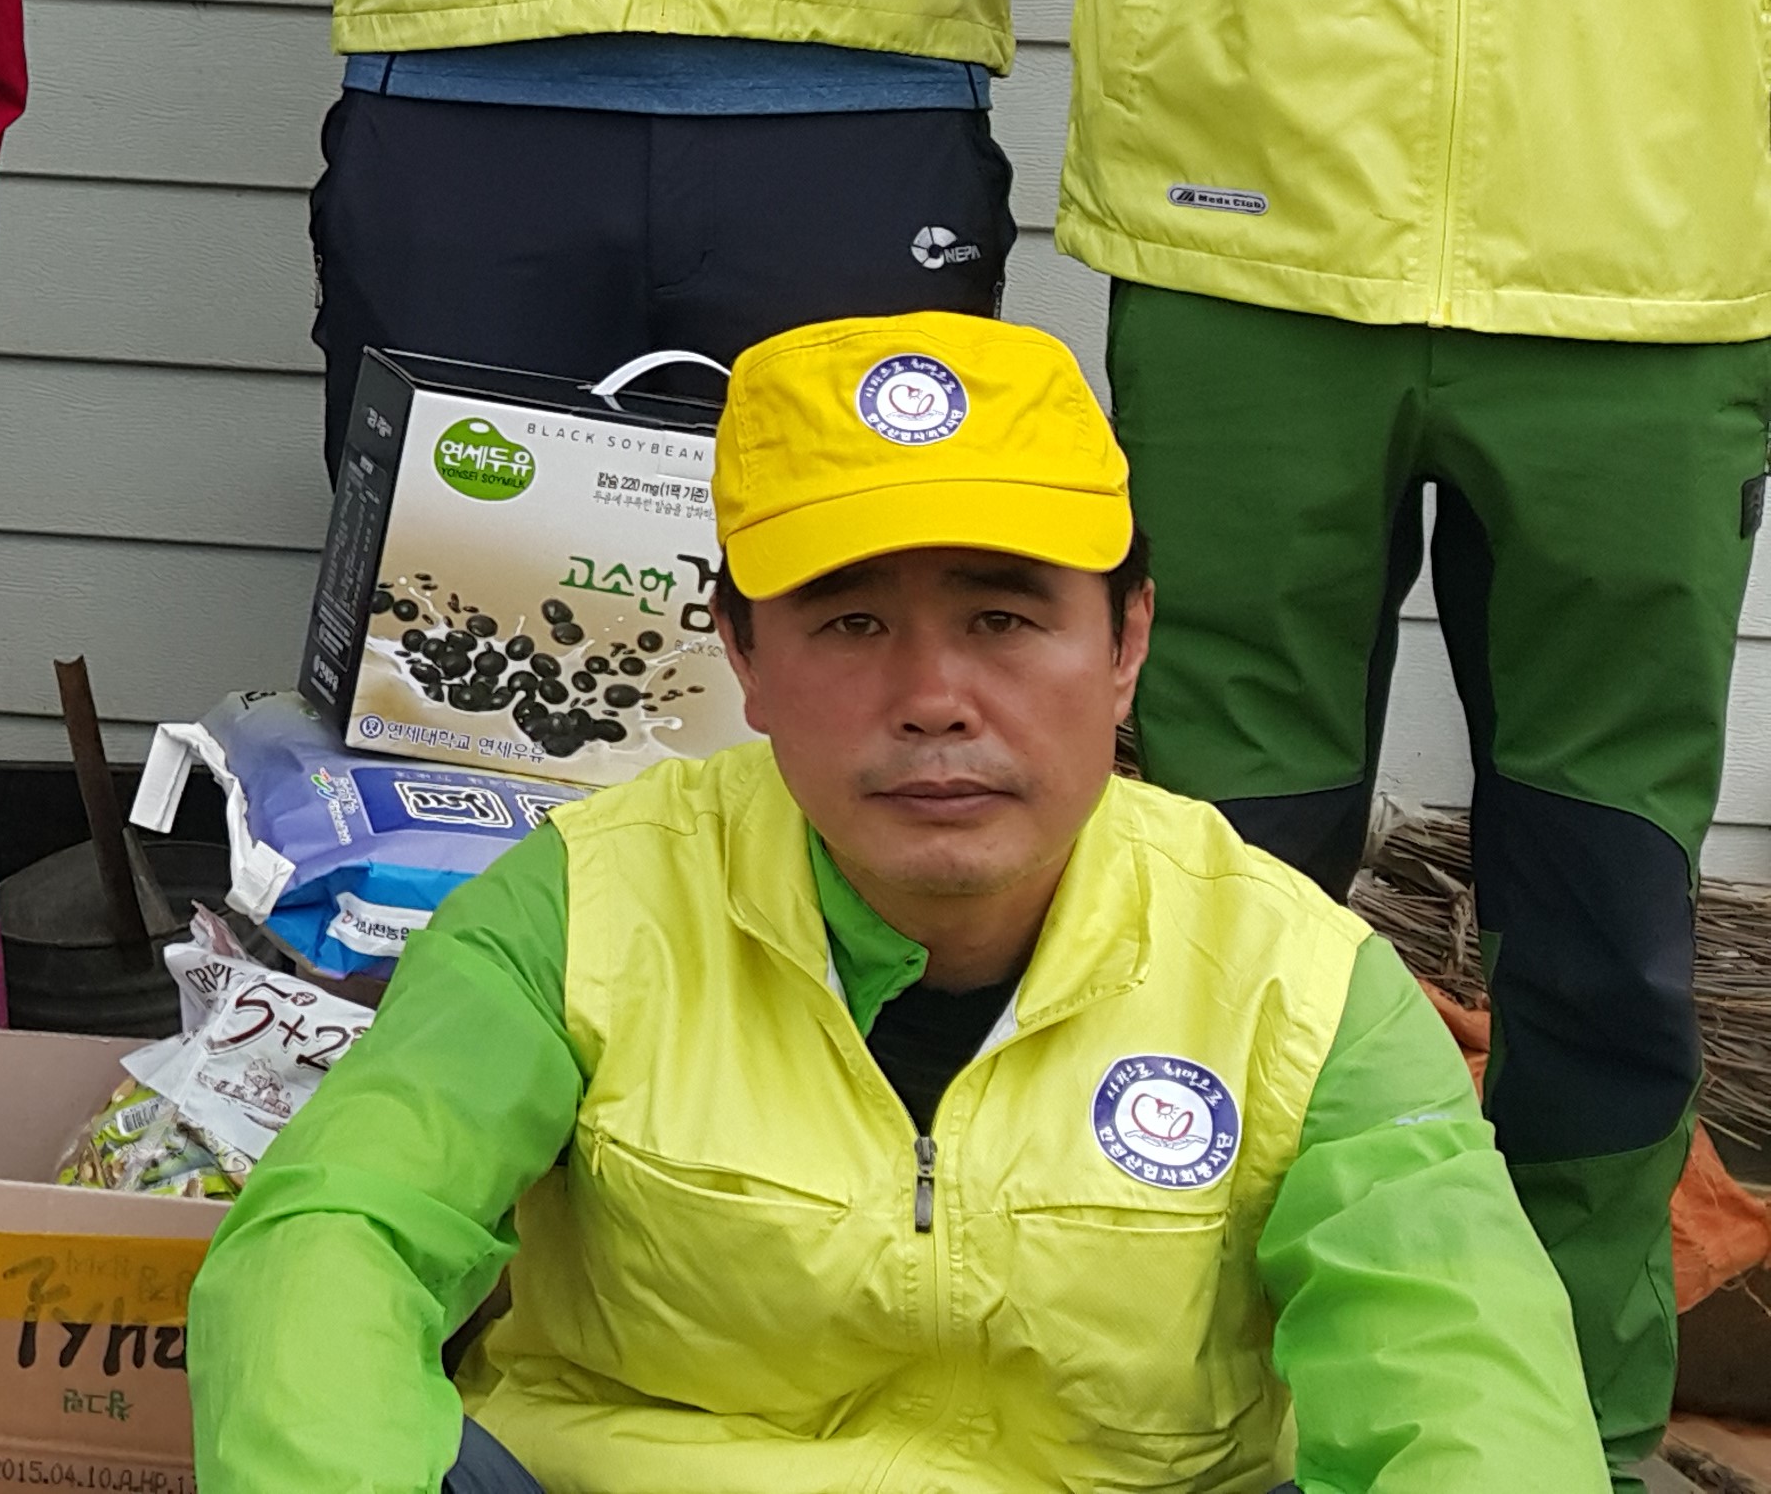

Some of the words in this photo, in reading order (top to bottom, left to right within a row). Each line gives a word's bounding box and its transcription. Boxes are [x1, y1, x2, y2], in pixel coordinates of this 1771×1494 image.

[943, 245, 981, 263] NEPA
[440, 440, 532, 478] 연세두유
[526, 422, 596, 444] BLACK
[607, 435, 706, 462] SOYBEAN
[441, 467, 478, 482] YONSEI
[481, 472, 526, 489] SOYMILK
[620, 475, 641, 492] 220
[559, 555, 677, 617] 고소한
[386, 722, 471, 751] 연세대학교
[478, 736, 546, 764] 연세우유
[61, 1389, 134, 1422] 참그린
